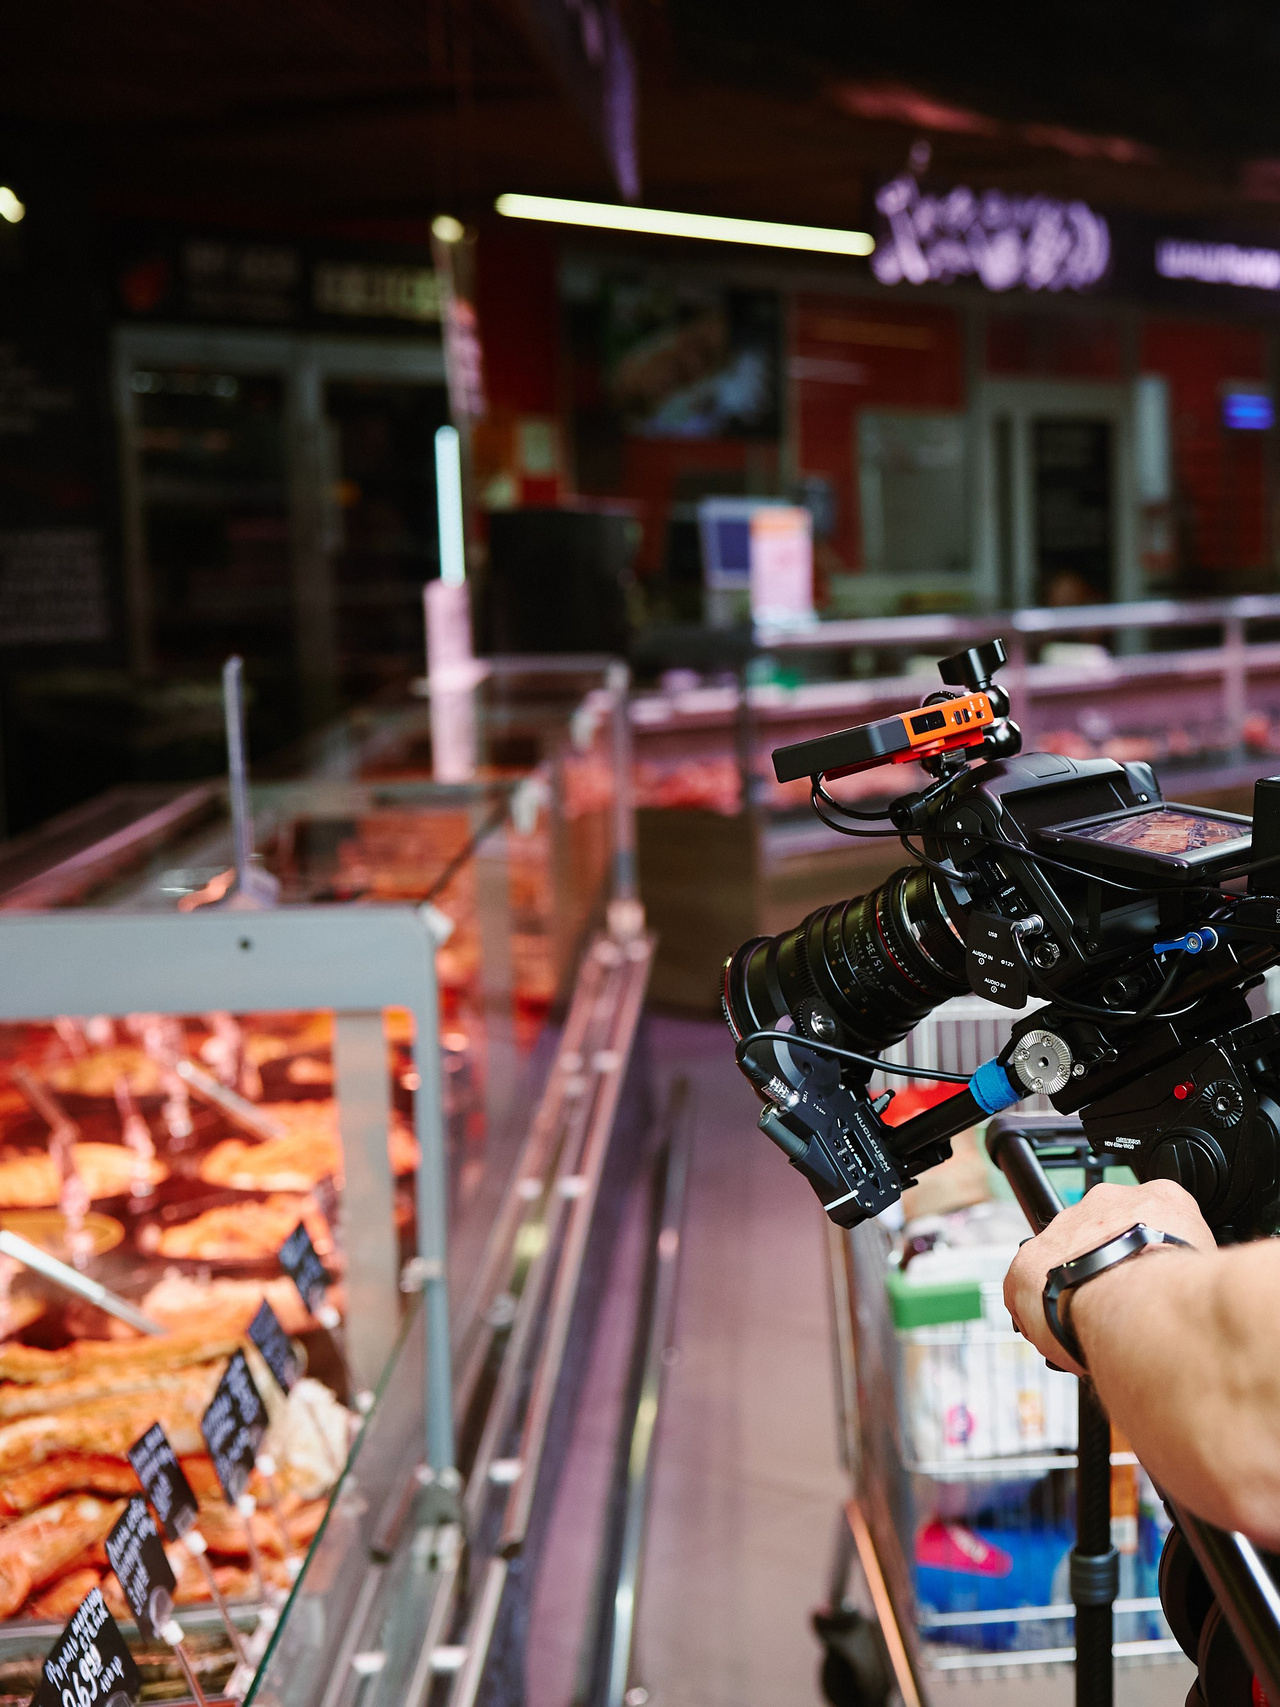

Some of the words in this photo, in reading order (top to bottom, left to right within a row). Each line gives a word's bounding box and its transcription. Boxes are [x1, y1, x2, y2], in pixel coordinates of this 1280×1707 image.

[987, 930, 998, 939] USB
[971, 949, 988, 960] AUDIO
[984, 977, 1000, 988] AUDIO
[854, 1112, 891, 1173] NUCLEUS-M
